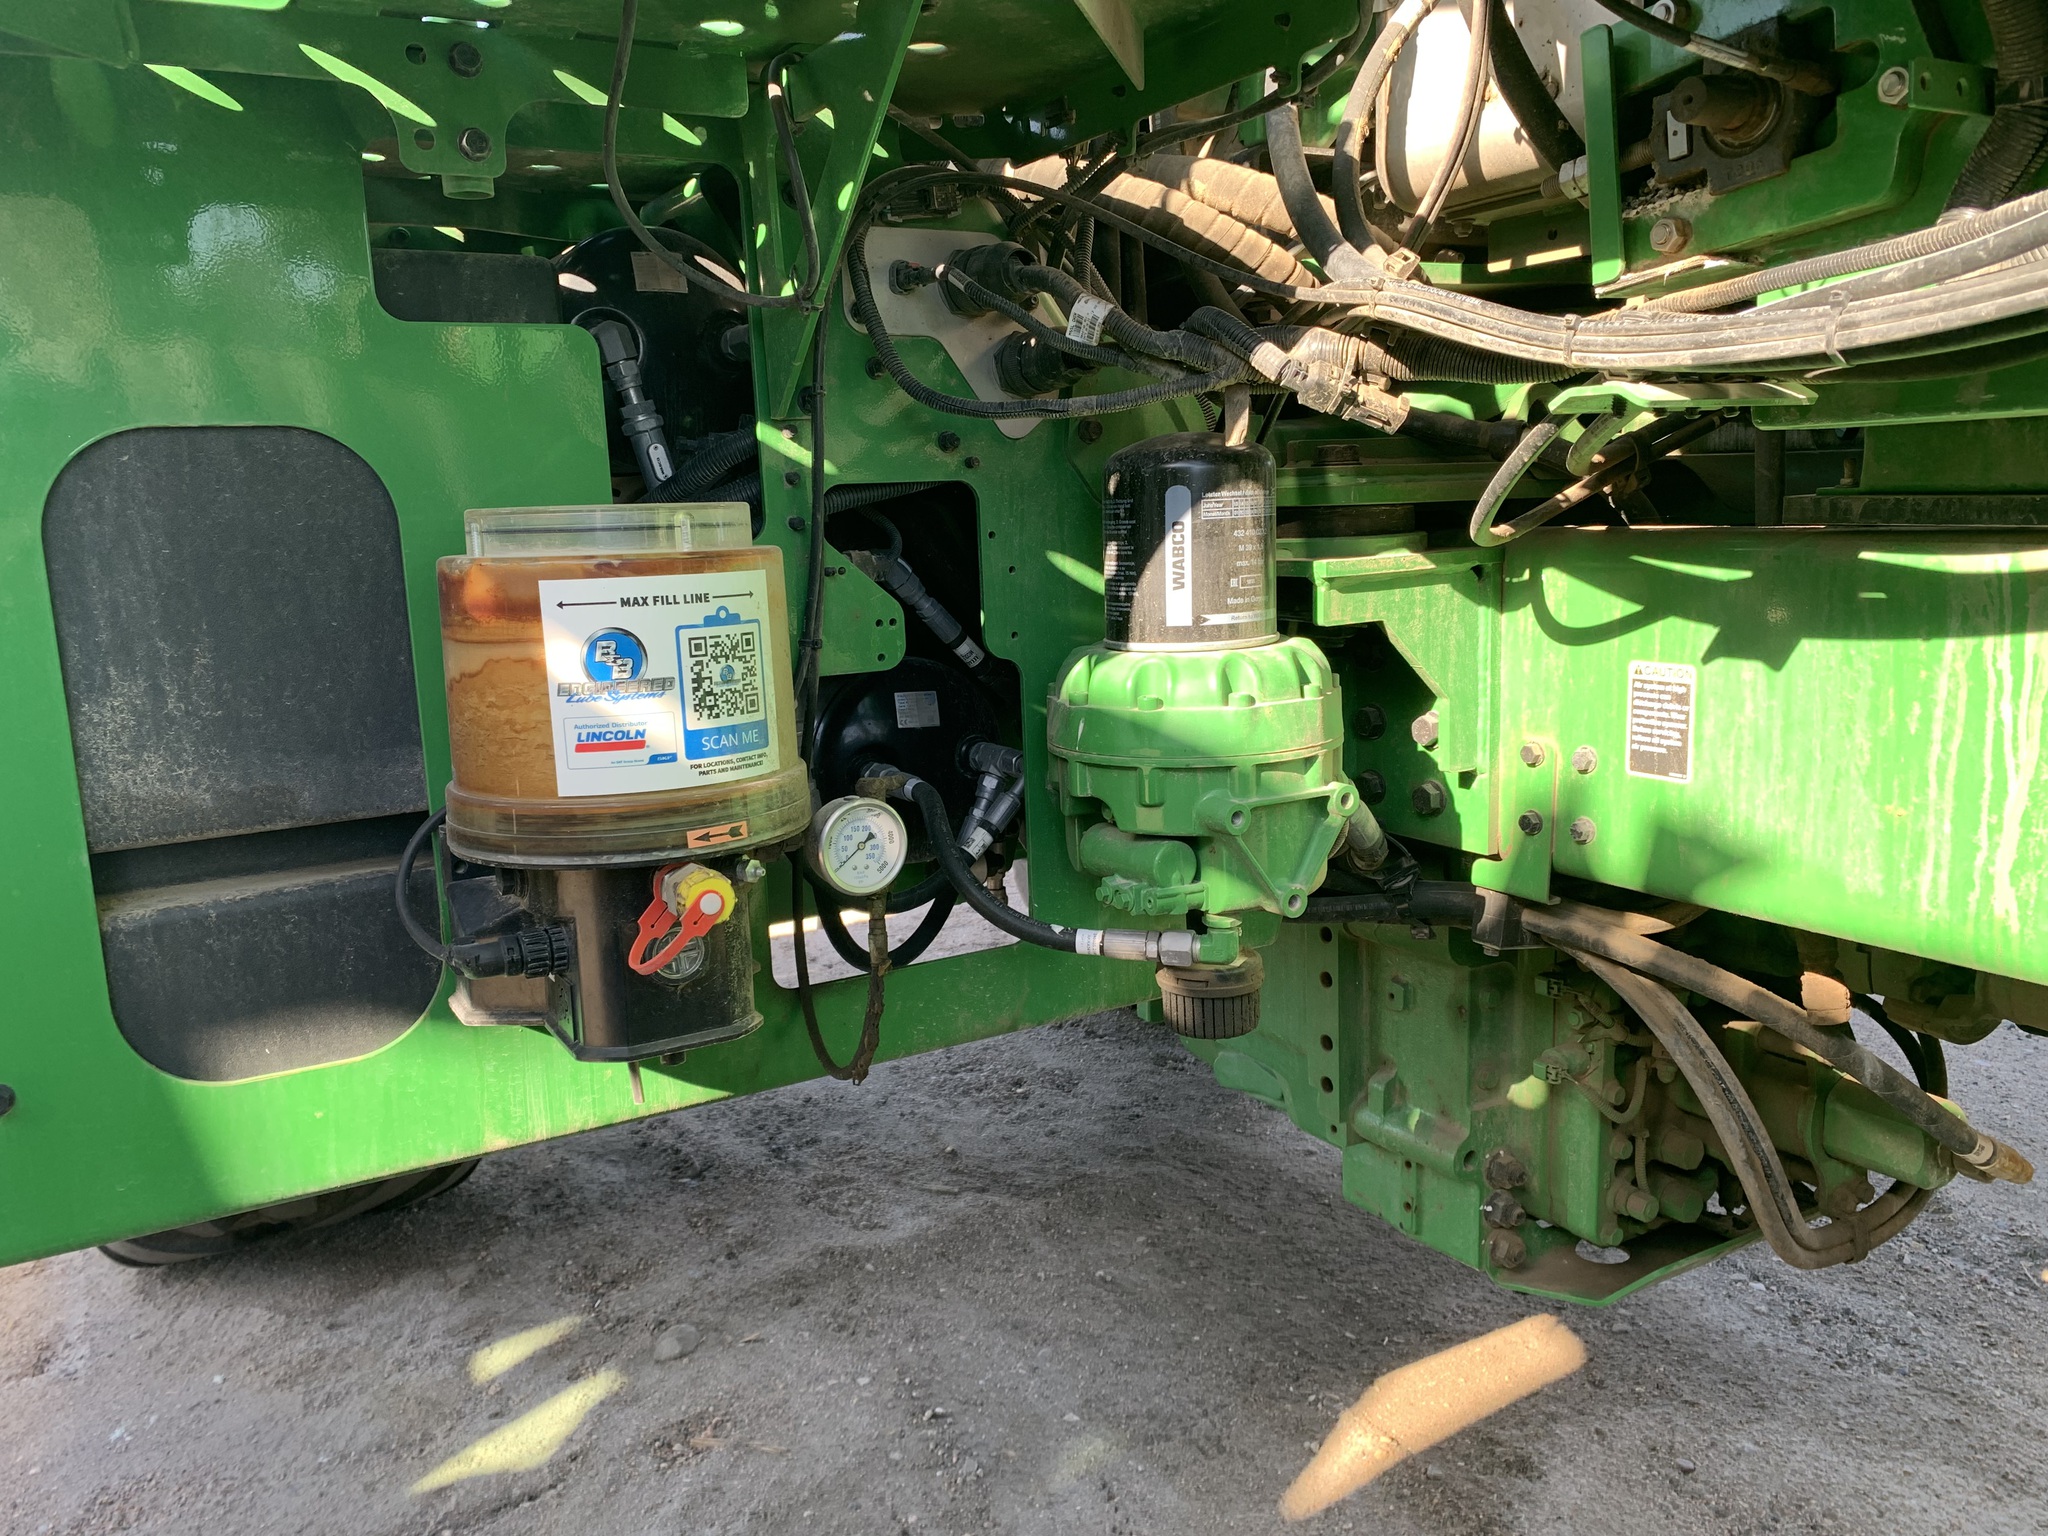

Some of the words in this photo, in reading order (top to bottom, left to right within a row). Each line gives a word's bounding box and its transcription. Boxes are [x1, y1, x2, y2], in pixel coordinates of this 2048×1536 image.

[1172, 521, 1185, 591] WABCO
[620, 596, 649, 607] MAX
[653, 595, 680, 606] FILL
[683, 593, 710, 604] LINE
[1227, 597, 1244, 605] Made
[1644, 665, 1692, 679] CAUTION
[557, 676, 676, 697] ENGINEERED
[566, 692, 602, 704] Lube
[604, 690, 666, 704] Systems
[577, 729, 646, 742] LINCOLN
[701, 732, 738, 751] SCAN
[745, 729, 759, 744] ME
[703, 759, 736, 768] LOCATIONS,
[736, 754, 757, 763] CONTACT
[877, 860, 889, 874] 5000
